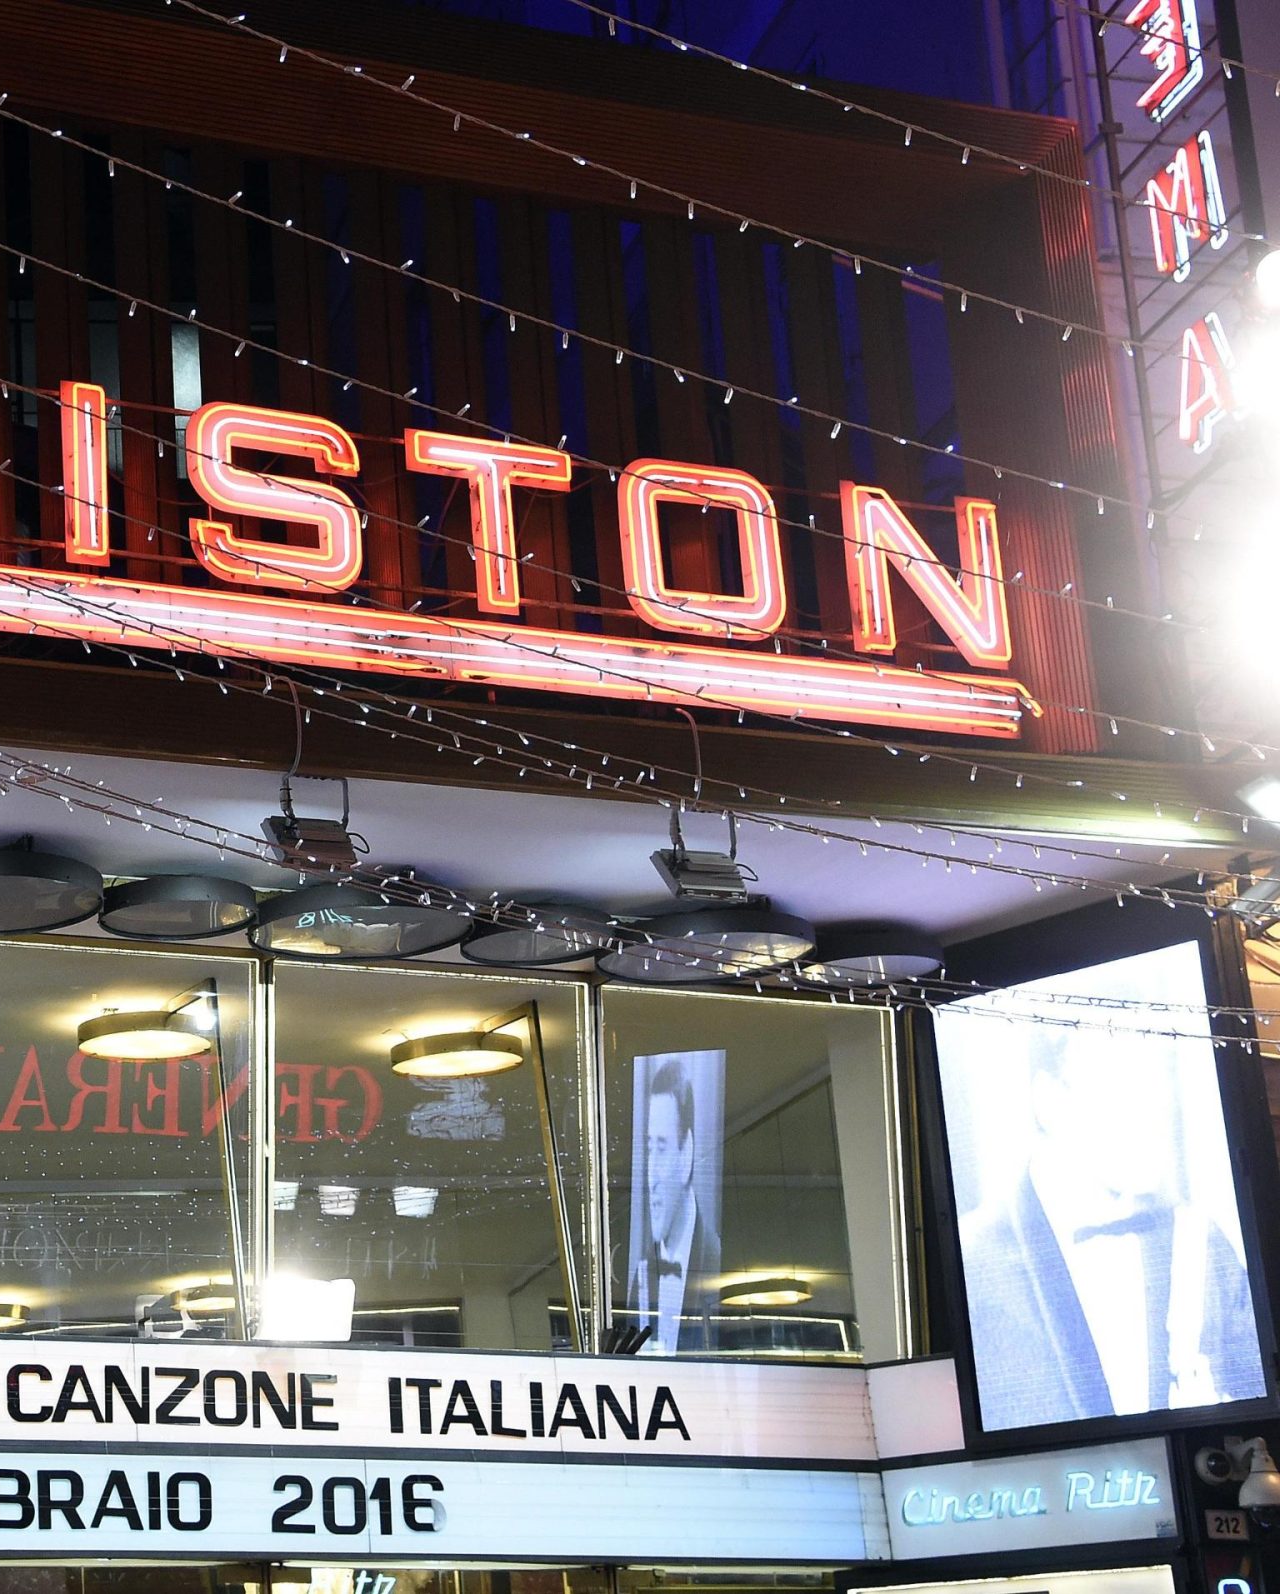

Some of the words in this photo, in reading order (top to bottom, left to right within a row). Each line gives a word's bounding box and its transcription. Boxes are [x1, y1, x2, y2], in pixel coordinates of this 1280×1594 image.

[7, 1364, 340, 1432] CANZONE
[388, 1377, 691, 1441] ITALIANA
[271, 1474, 446, 1536] 2016
[902, 1486, 1047, 1527] Cinema
[1213, 1517, 1241, 1536] 212
